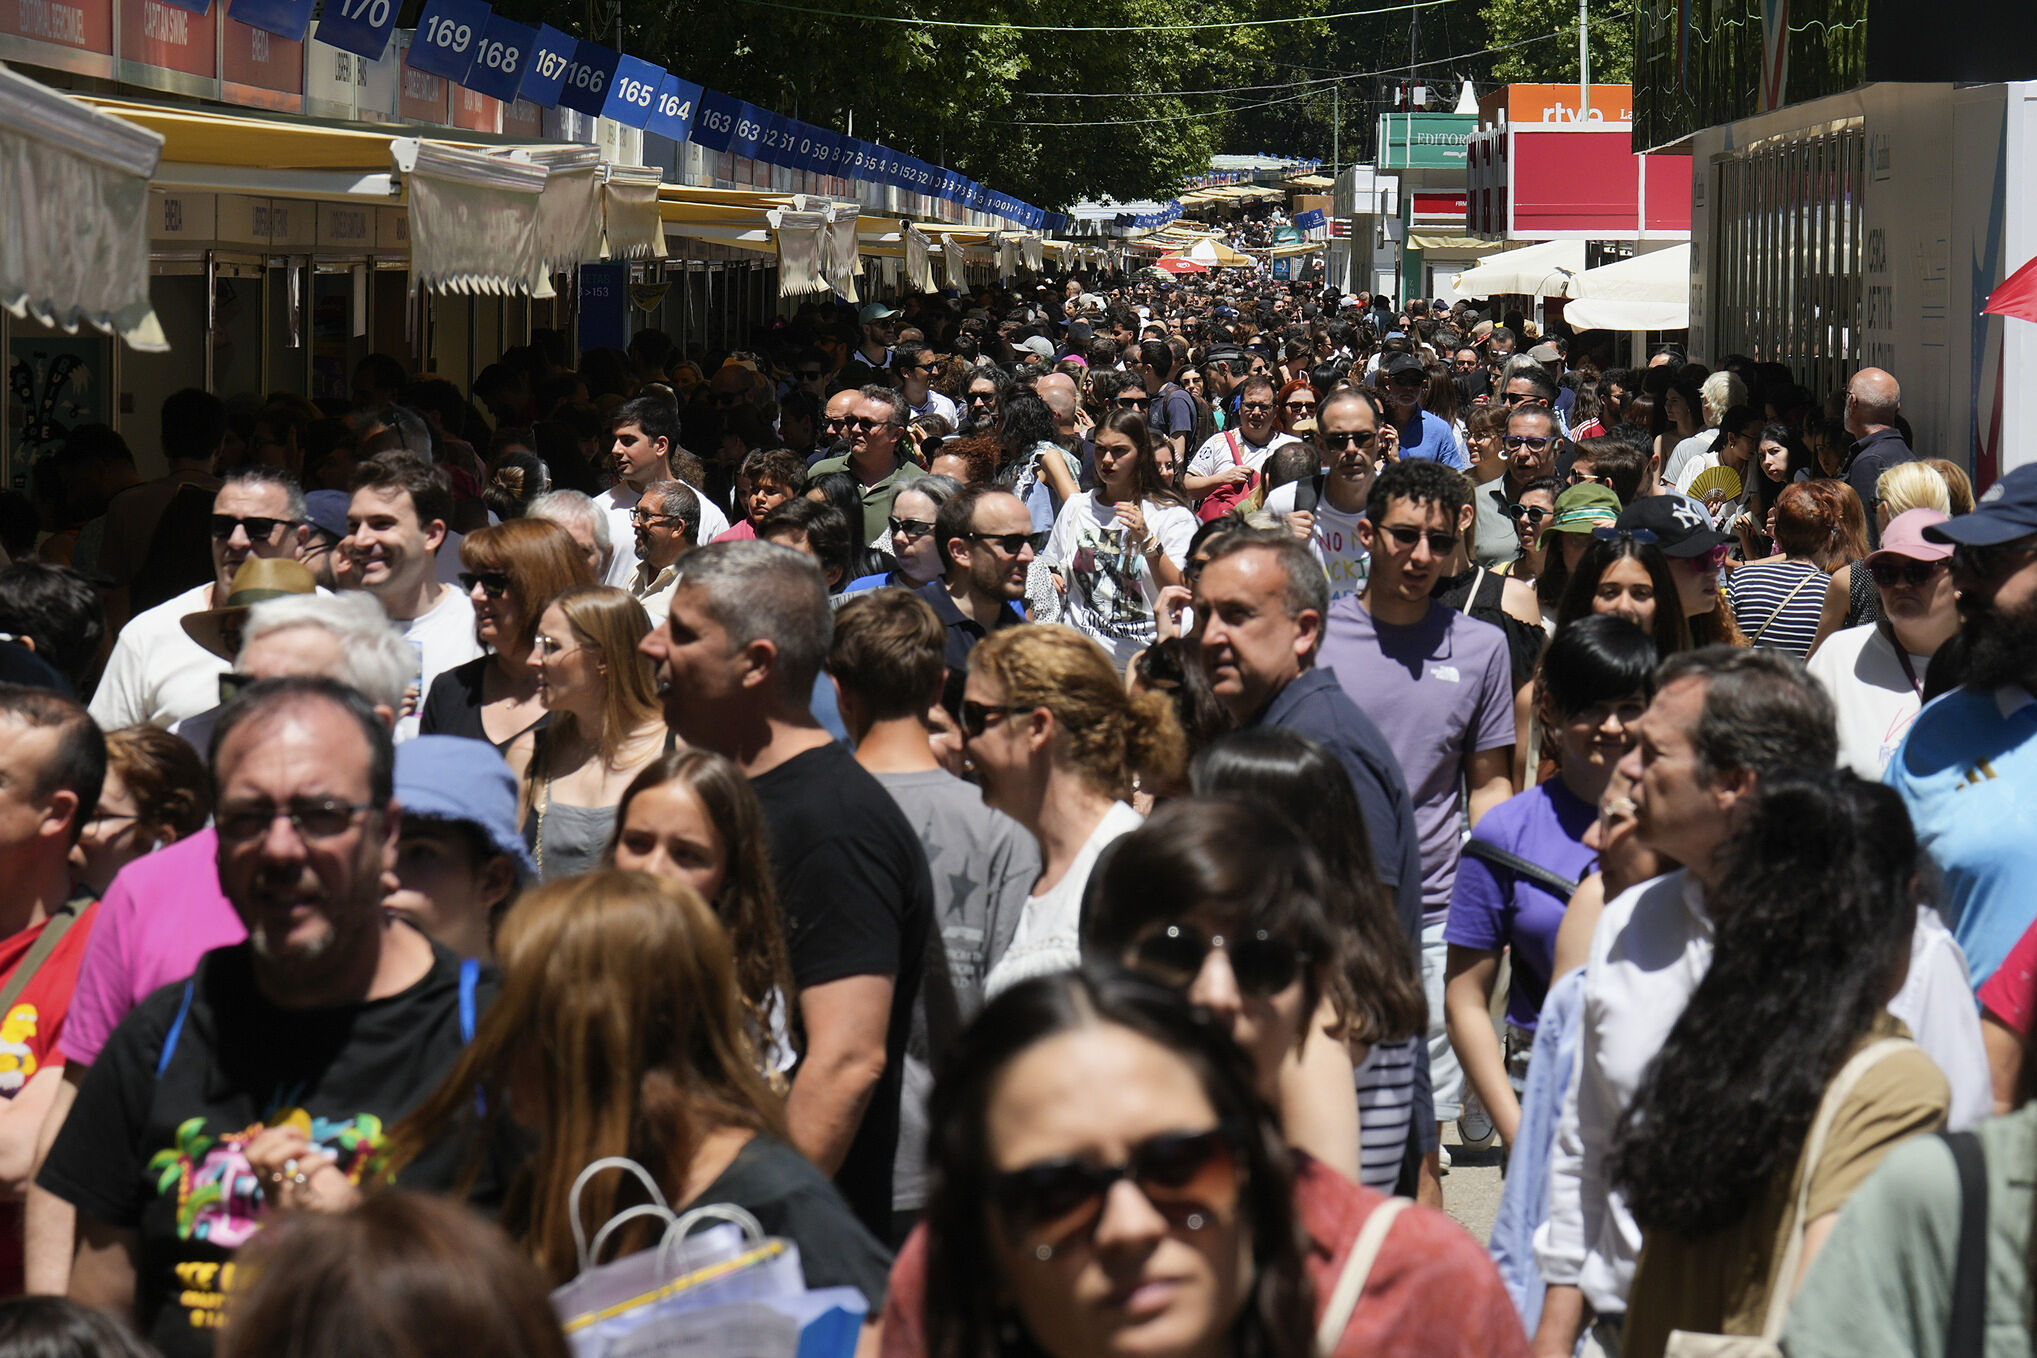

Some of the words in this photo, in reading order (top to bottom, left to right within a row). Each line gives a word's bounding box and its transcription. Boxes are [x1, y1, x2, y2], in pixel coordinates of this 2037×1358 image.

[426, 15, 472, 53] 169
[477, 38, 519, 73] 168
[535, 49, 567, 81] 167
[567, 62, 605, 93] 166
[618, 77, 653, 107] 165
[658, 93, 691, 121] 164
[703, 109, 732, 133] 163
[1317, 531, 1342, 552] NO
